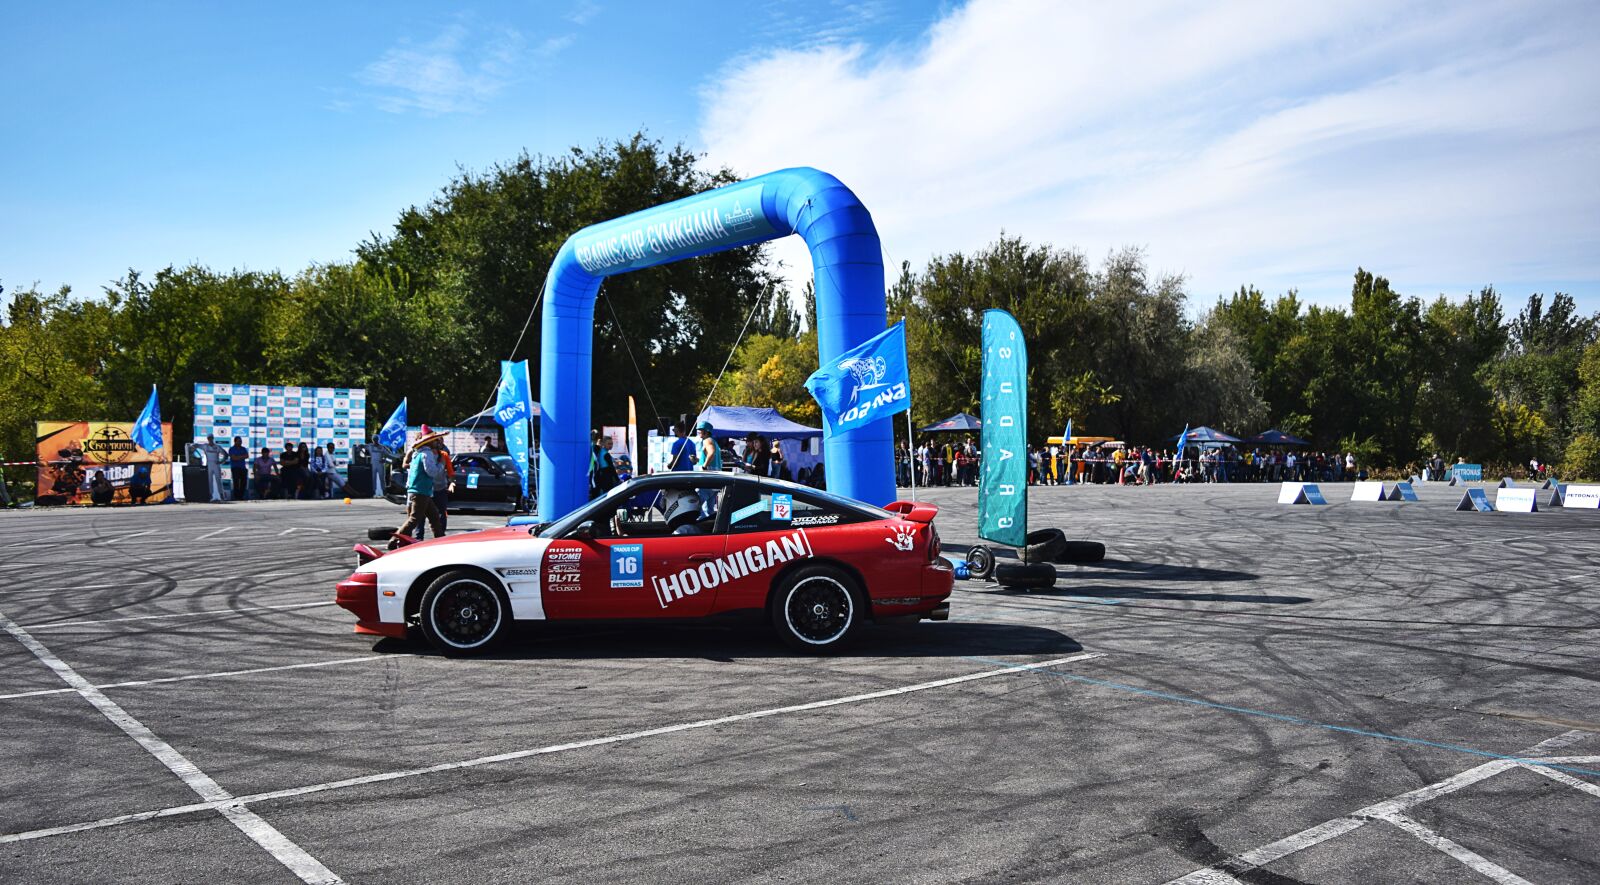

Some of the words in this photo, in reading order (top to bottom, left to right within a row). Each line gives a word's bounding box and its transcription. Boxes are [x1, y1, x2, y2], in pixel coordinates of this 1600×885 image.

[576, 237, 625, 272] GRADUS
[621, 229, 646, 260] CUP
[647, 208, 729, 254] GYMKHANA
[1454, 468, 1481, 476] PETRONAS
[775, 504, 785, 513] 12
[616, 556, 637, 574] 16
[548, 573, 580, 582] BLITZ
